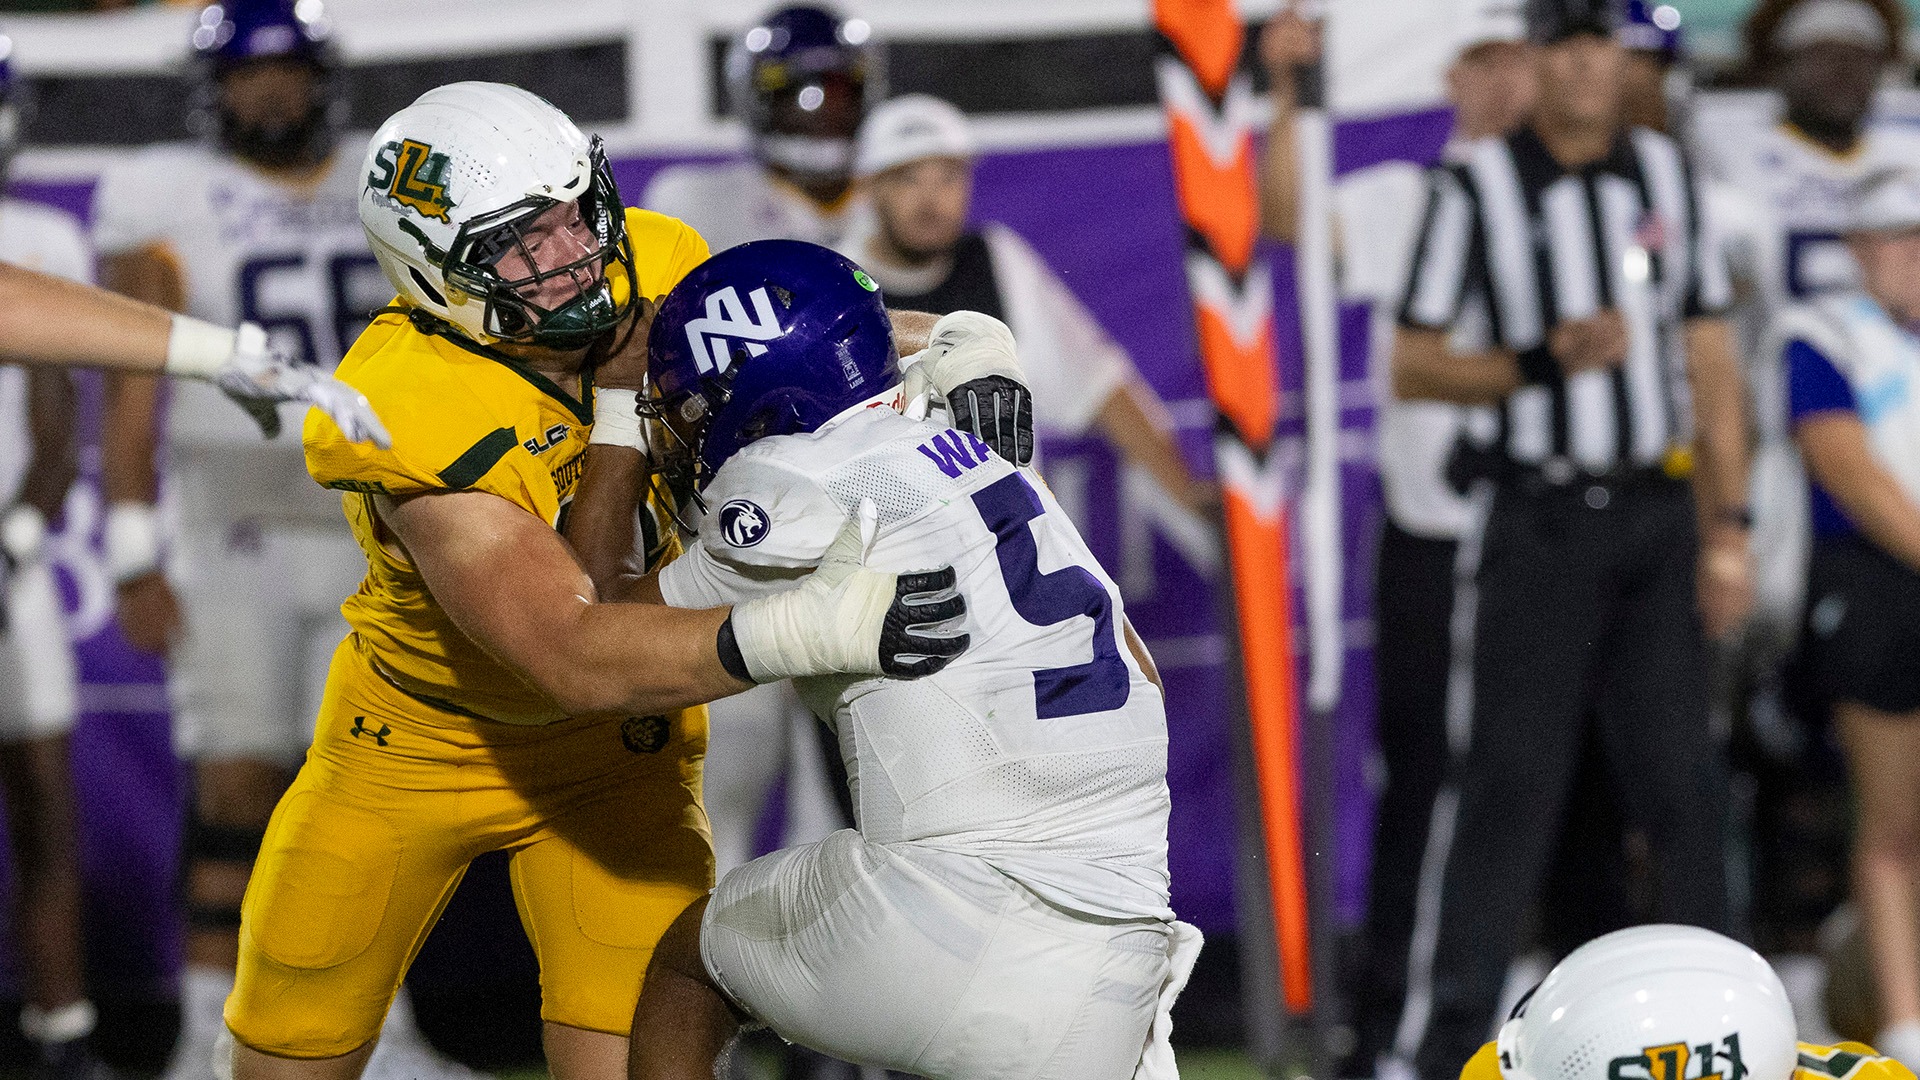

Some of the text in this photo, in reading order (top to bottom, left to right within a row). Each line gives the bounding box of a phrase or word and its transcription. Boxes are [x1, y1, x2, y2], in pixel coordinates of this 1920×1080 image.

[582, 294, 605, 312] Rddell
[522, 423, 571, 457] SLC
[970, 470, 1131, 720] 5
